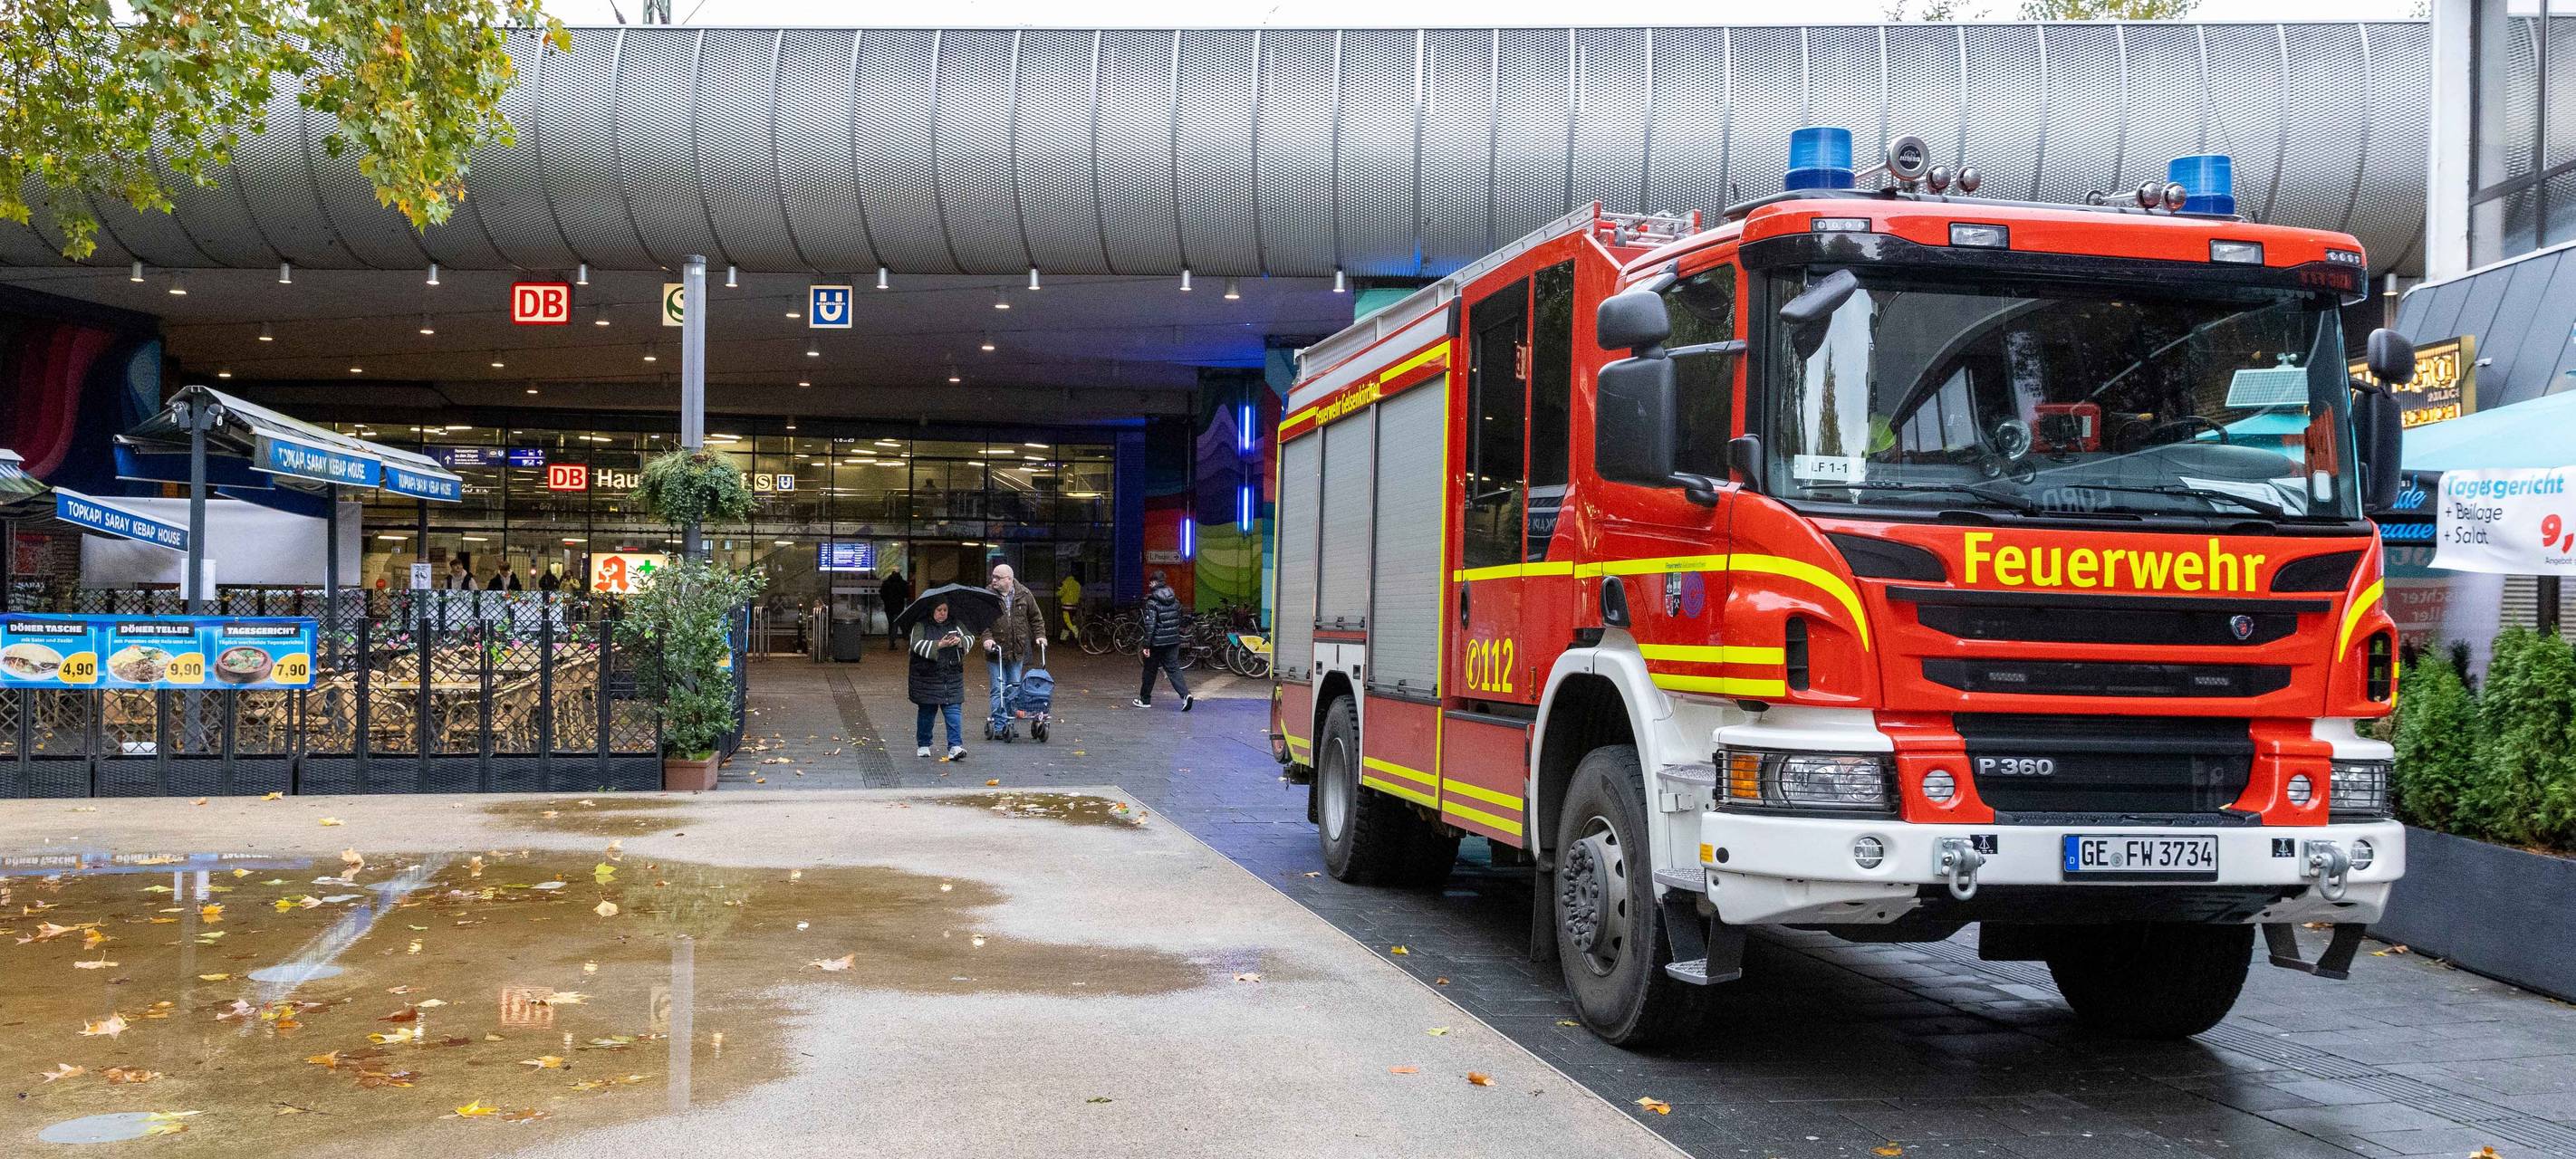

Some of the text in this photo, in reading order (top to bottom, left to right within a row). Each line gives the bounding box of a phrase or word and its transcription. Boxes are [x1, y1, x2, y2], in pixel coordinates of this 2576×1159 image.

[519, 289, 563, 318] DB
[820, 292, 842, 321] U
[1315, 380, 1381, 426] Feuerwehr Gelsenkirchen
[307, 454, 327, 470] SARAY
[328, 457, 346, 476] KEBAP
[347, 462, 365, 480] HOUSE
[1812, 462, 1847, 474] LF 1-1
[553, 467, 583, 487] DB
[757, 475, 770, 489] S
[780, 476, 792, 488] U
[2448, 473, 2564, 499] Tagesgericht
[2456, 503, 2503, 523] Beilage
[68, 501, 181, 545] TOPKAPI SARAY KEBAP HOUSE
[2456, 526, 2489, 544] Salat
[1964, 532, 2266, 592] Feuerwehr
[2544, 557, 2572, 566] Angebot
[11, 623, 82, 633] DÖNER TASCHE
[120, 624, 189, 634] DÖNER TELLER
[63, 663, 93, 677] 4,90
[170, 663, 201, 677] 9,90
[276, 664, 306, 678] 7,90
[1482, 637, 1514, 694] 112
[1979, 759, 2053, 775] P 360
[2069, 857, 2075, 865] D
[2082, 840, 2213, 867] GE FW 3734
